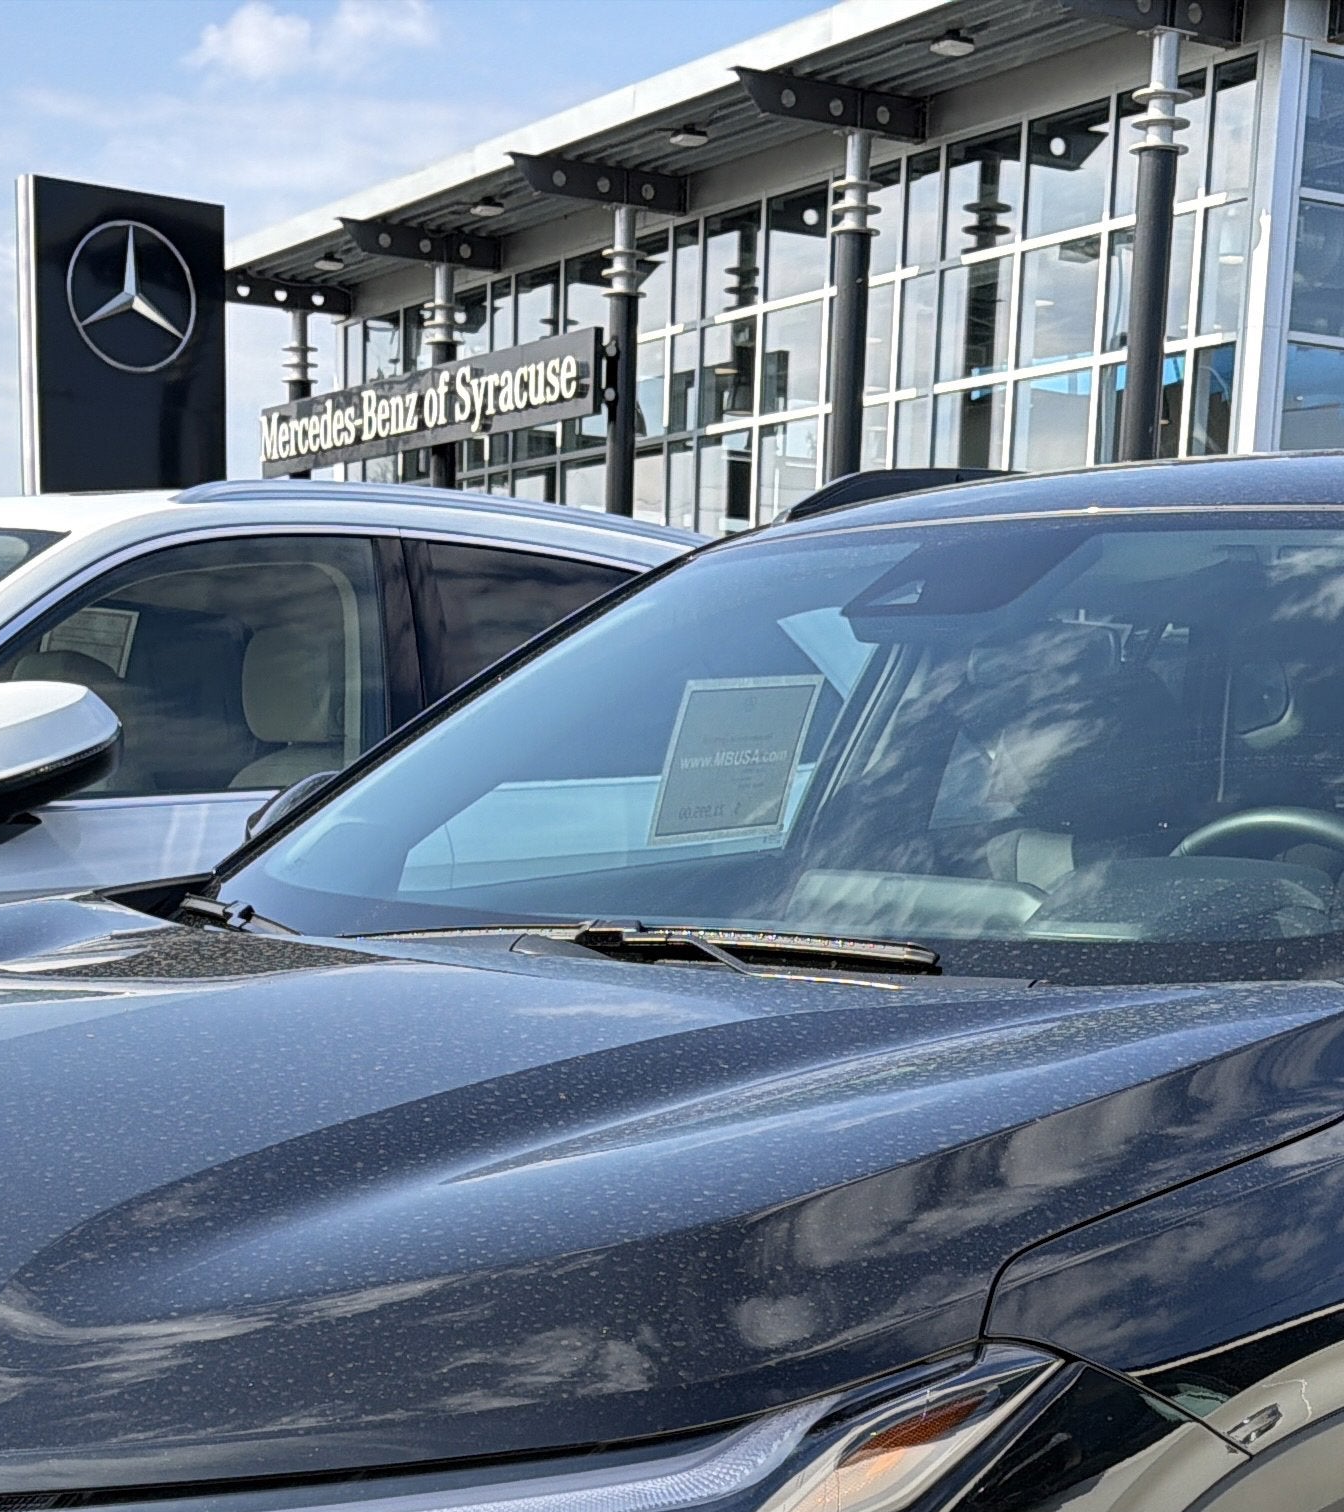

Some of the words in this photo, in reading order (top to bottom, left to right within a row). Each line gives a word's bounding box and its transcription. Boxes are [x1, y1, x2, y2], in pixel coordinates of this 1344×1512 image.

[259, 388, 418, 462] Mercedes-Benz
[423, 370, 449, 426] of
[455, 354, 578, 432] Syracuse
[679, 749, 788, 770] www.MBUSA.com
